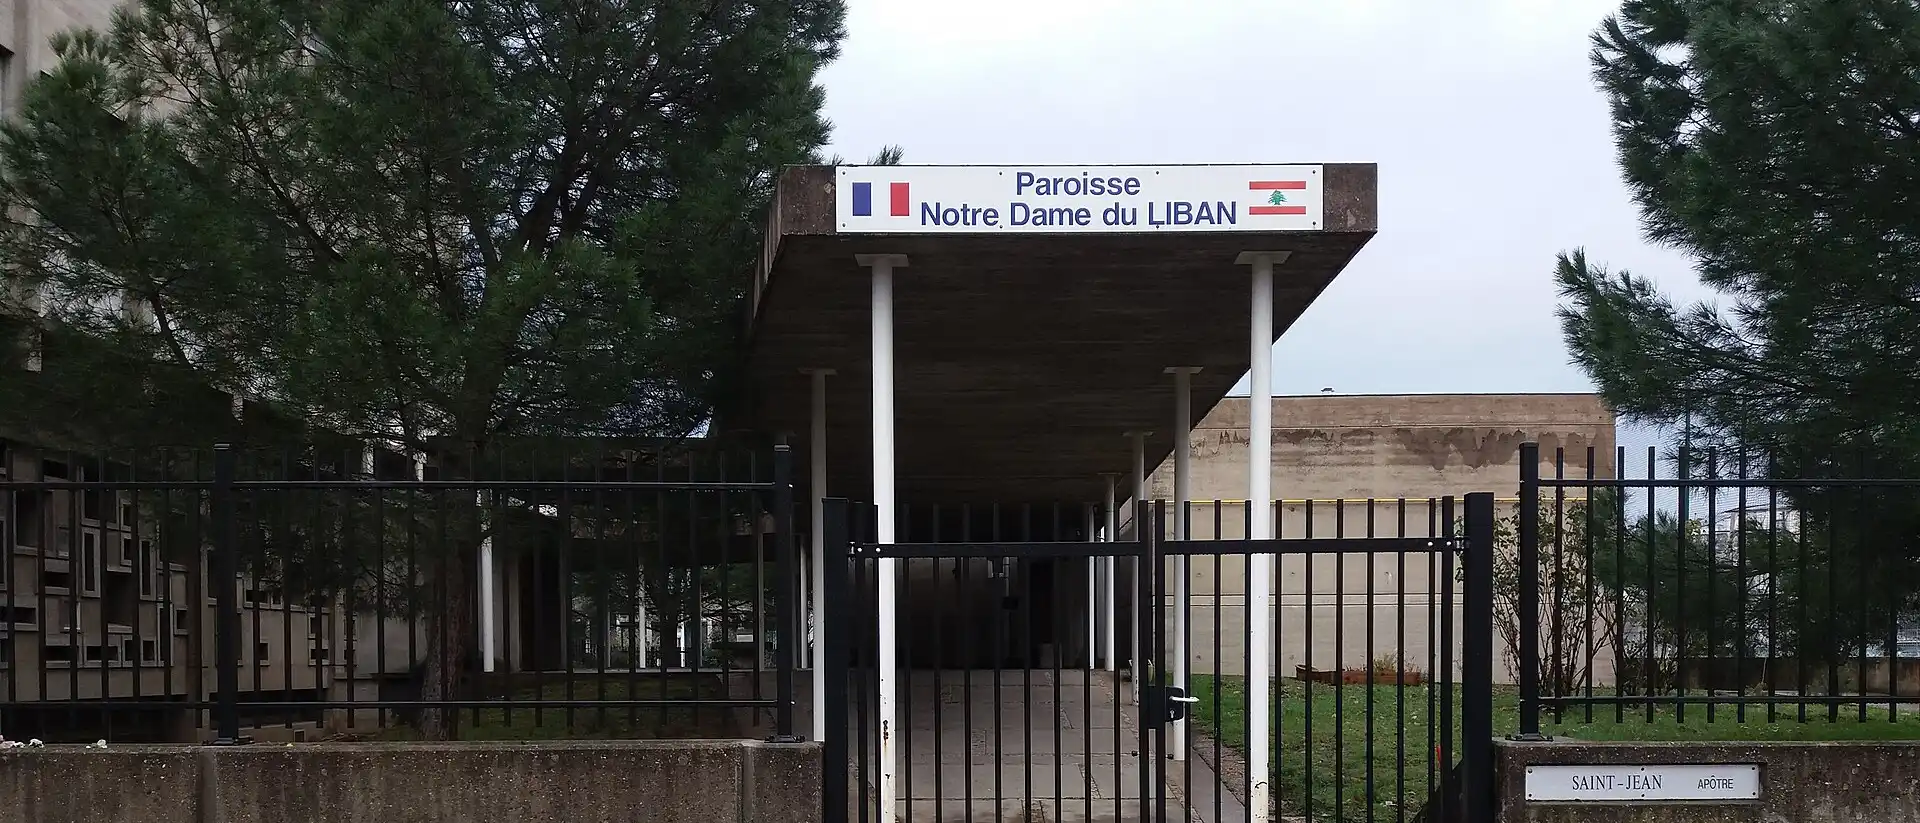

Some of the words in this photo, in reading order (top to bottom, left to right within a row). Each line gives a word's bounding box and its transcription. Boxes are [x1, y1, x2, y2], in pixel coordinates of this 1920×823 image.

[1015, 172, 1141, 196] Paroisse
[920, 202, 1000, 227] Notre
[1009, 202, 1092, 227] Dame
[1103, 201, 1138, 227] du
[1148, 201, 1238, 226] LIBAN
[1572, 774, 1663, 790] SAINT-JEAN
[1697, 775, 1734, 789] APÔTRE
